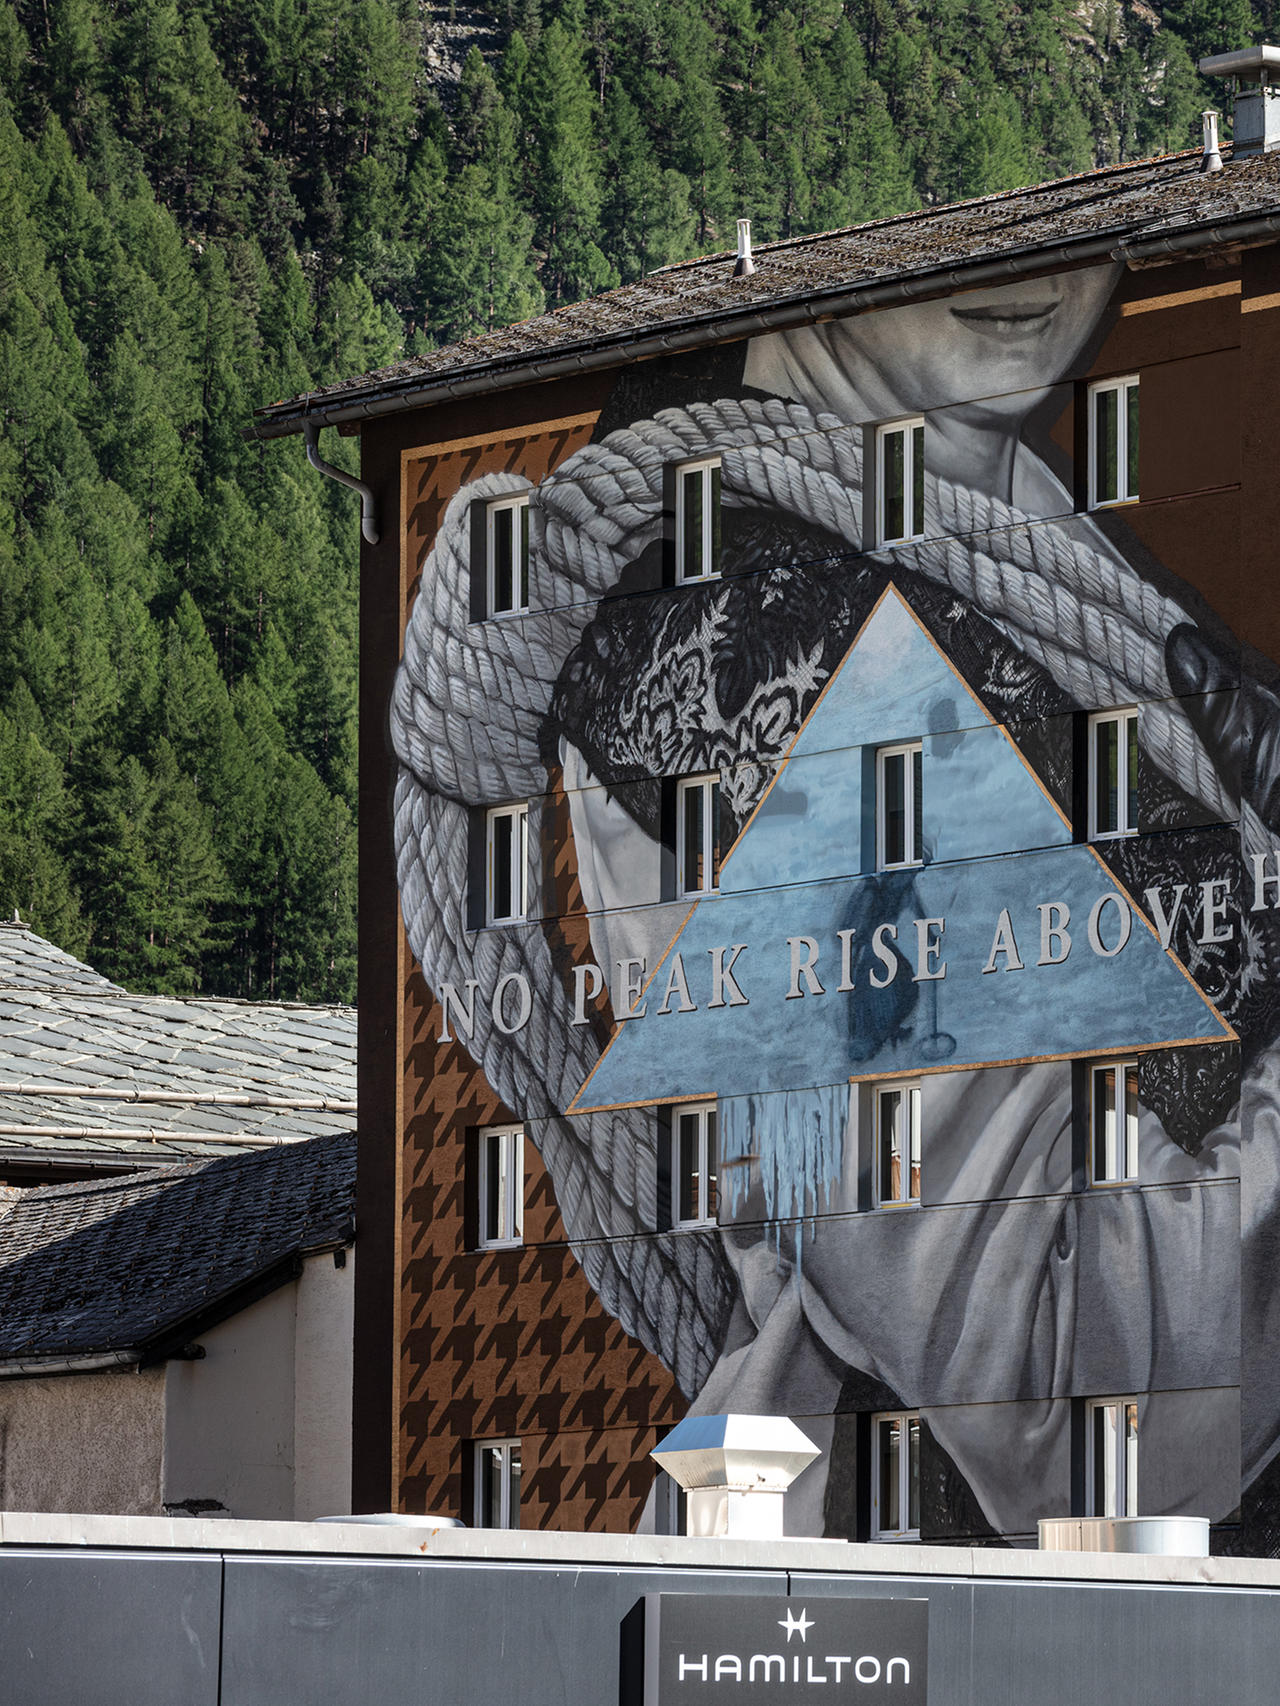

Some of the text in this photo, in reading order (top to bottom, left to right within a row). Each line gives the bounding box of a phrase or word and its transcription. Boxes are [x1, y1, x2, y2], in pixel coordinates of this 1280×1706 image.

[437, 973, 533, 1043] NO
[571, 944, 750, 1026] PEAK
[785, 917, 948, 1000] RISE
[982, 878, 1234, 974] ABOVE
[678, 1653, 911, 1685] HAMILTON
